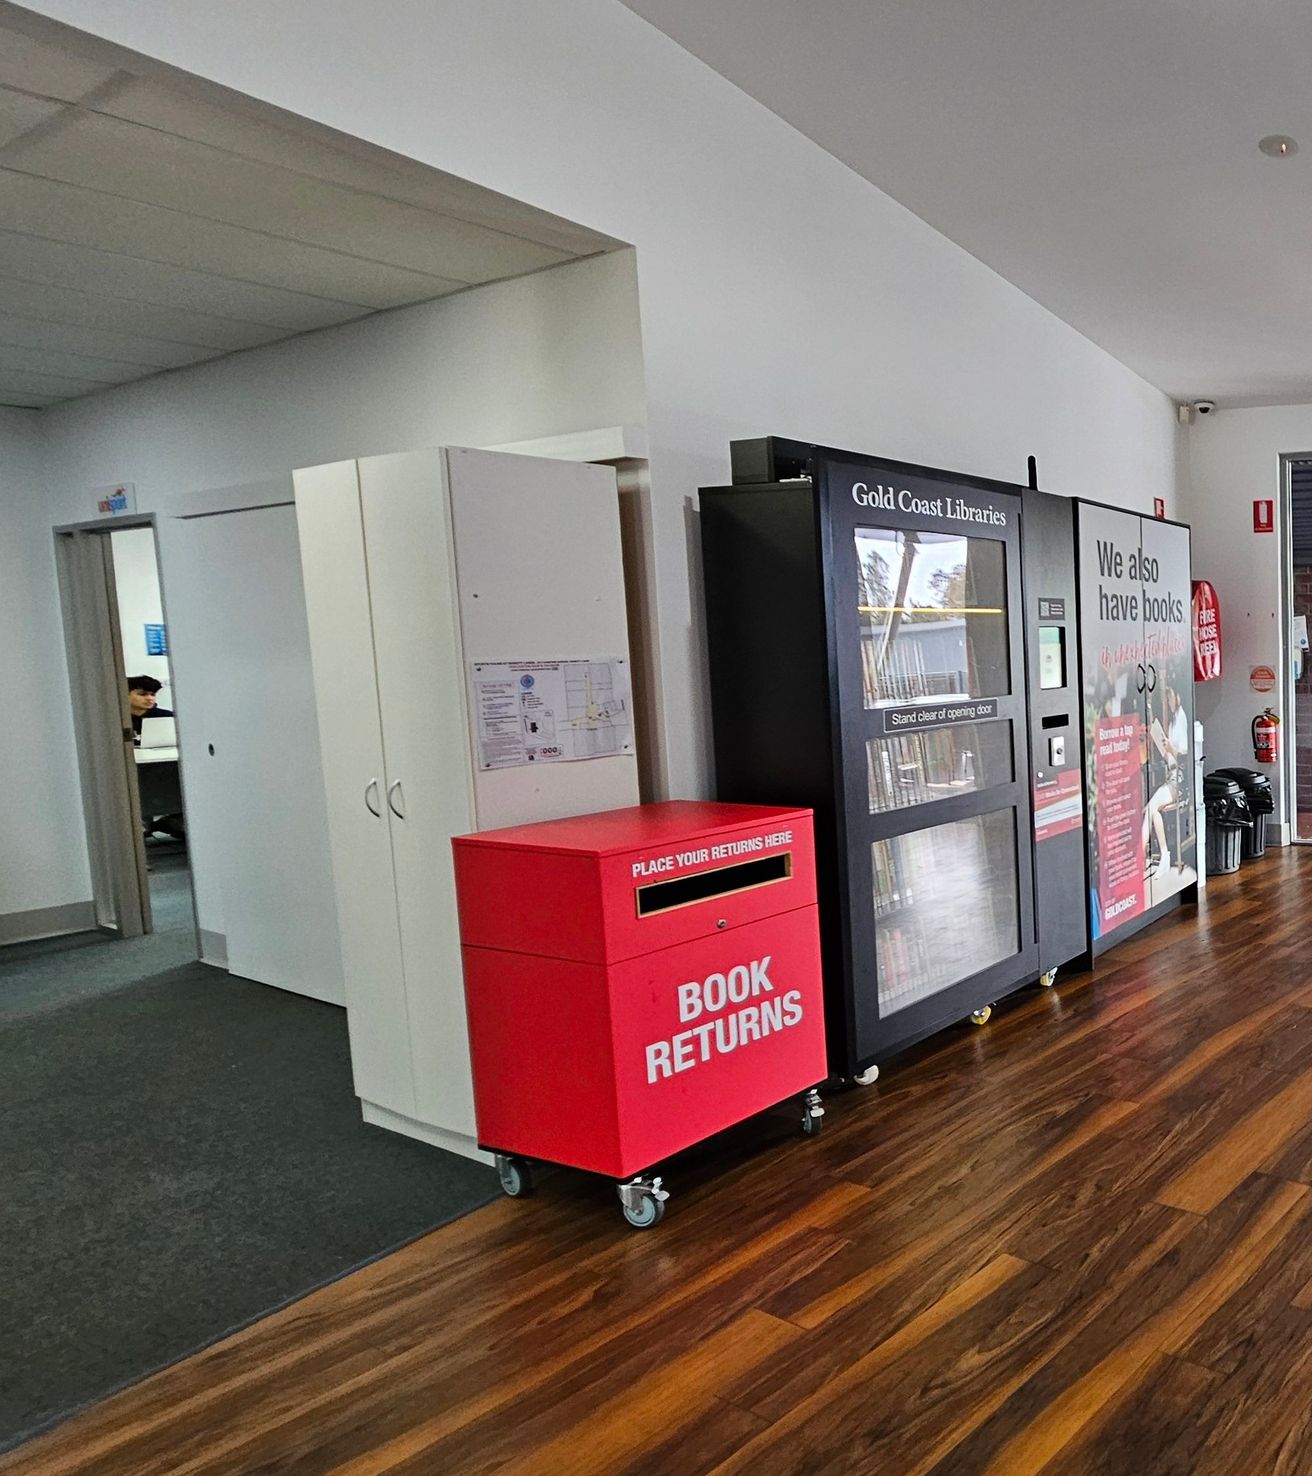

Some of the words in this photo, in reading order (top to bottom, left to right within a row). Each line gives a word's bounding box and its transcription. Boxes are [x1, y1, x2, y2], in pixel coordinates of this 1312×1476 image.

[852, 482, 896, 510] Gold
[898, 490, 943, 517] Coast
[946, 497, 1007, 526] Libraries
[1097, 540, 1123, 579] We
[1128, 547, 1159, 584] also
[1099, 584, 1138, 622] have
[1200, 608, 1216, 625] FIRE
[891, 712, 917, 725] Stand
[918, 710, 937, 722] clear
[938, 708, 946, 720] of
[947, 706, 975, 720] opening
[976, 704, 992, 715] door
[631, 856, 674, 878] PLACE
[675, 849, 709, 867] YOUR
[711, 837, 763, 860] RETURNS
[765, 830, 793, 848] HERE
[677, 955, 774, 1023] BOOK
[645, 990, 803, 1084] RETURNS
